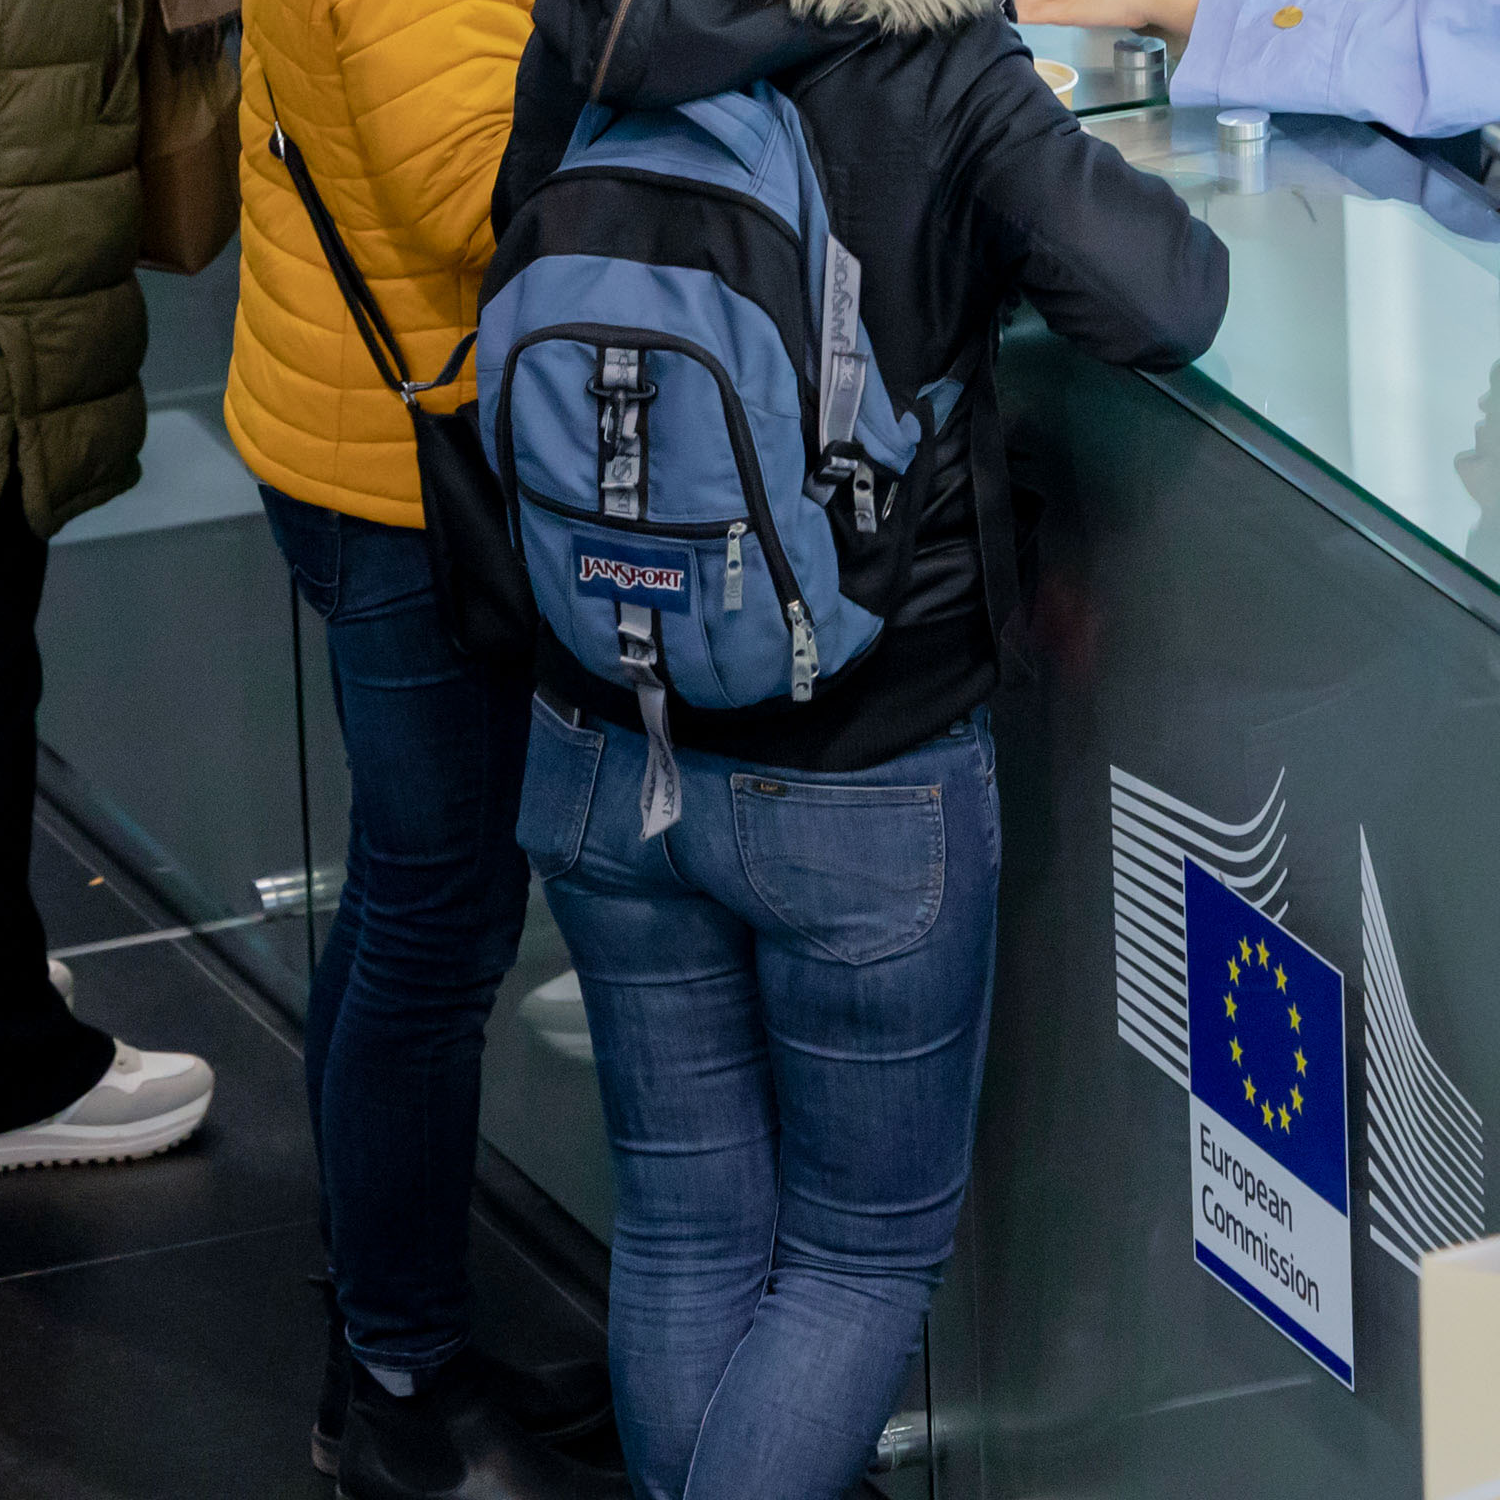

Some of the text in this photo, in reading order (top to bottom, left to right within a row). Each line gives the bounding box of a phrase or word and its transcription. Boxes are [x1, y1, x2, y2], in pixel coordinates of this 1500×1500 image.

[579, 555, 685, 592] JANSPORT
[1200, 1122, 1293, 1233] European
[1202, 1184, 1320, 1313] Commission
